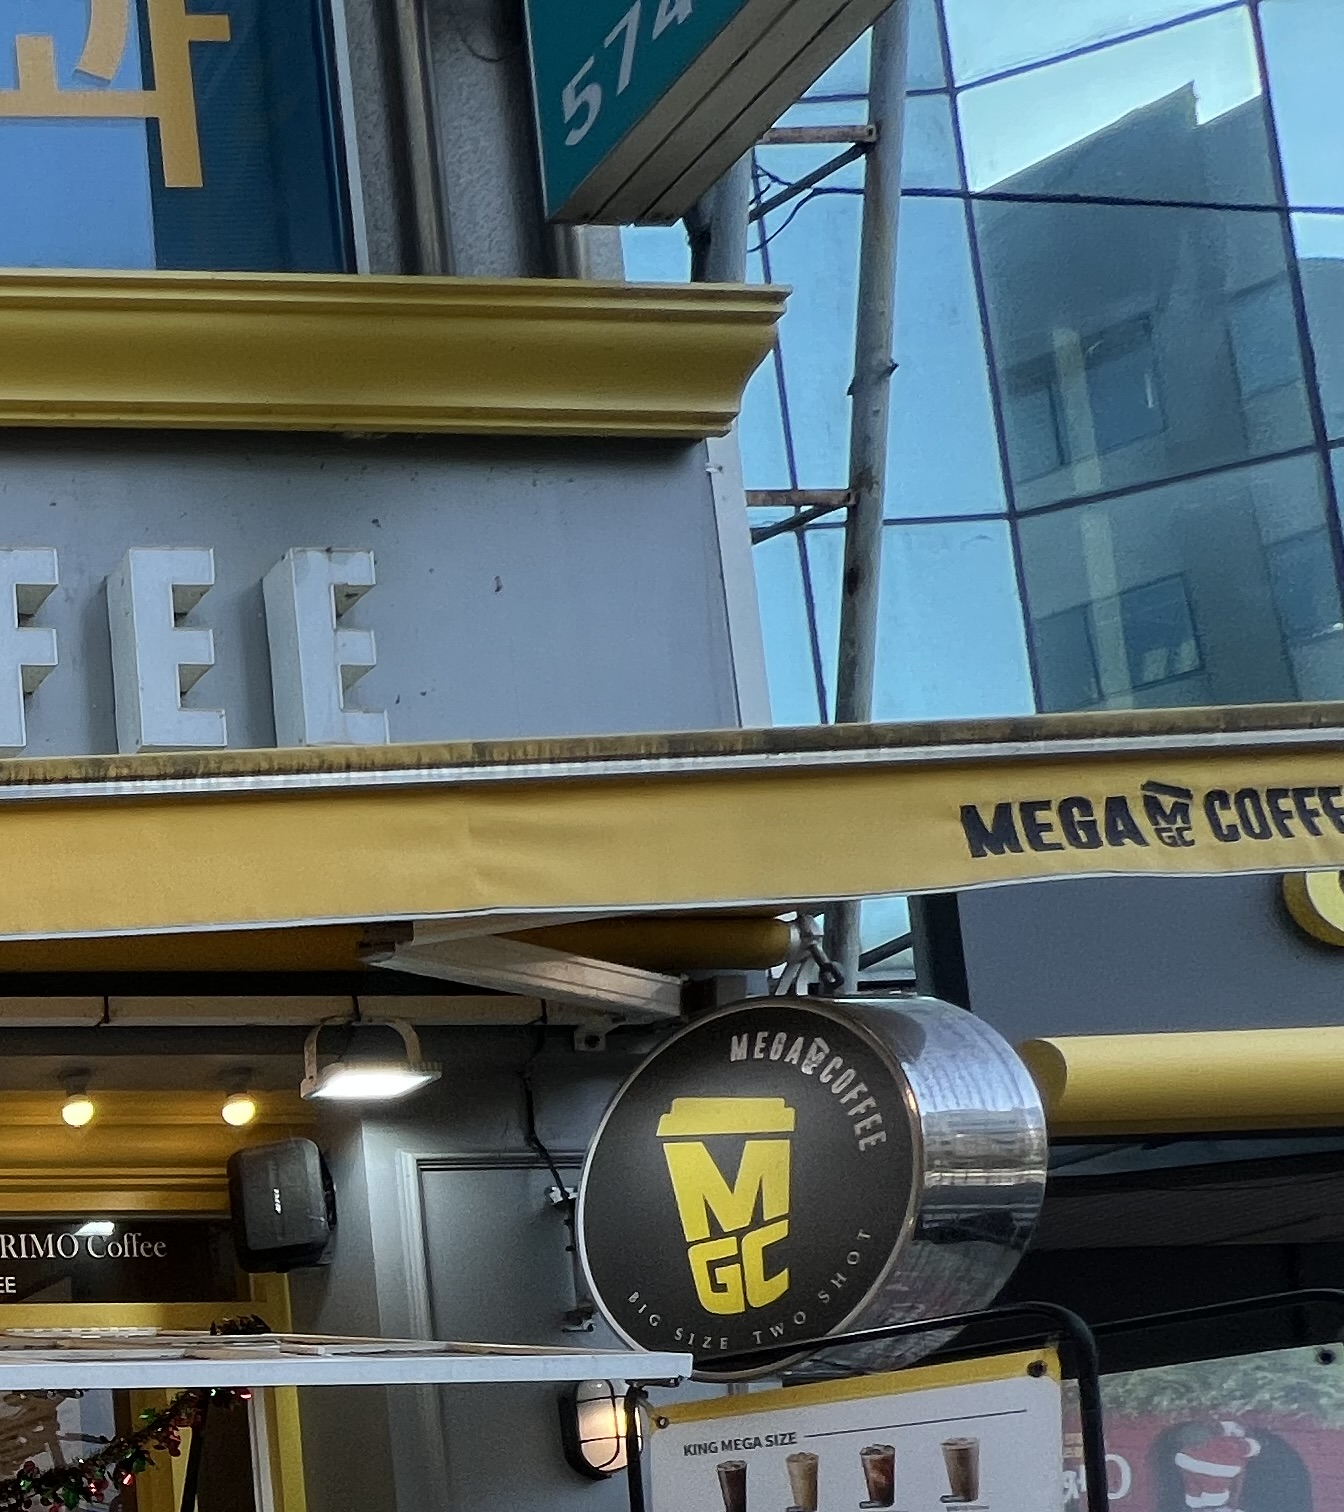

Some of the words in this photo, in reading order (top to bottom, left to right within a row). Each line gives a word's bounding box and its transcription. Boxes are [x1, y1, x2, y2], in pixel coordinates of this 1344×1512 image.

[959, 795, 1150, 859] MEGA
[729, 1031, 802, 1064] MEGA
[818, 1055, 887, 1153] COFFEE
[86, 1232, 168, 1260] Coffee
[662, 1138, 791, 1315] MGC
[625, 1290, 660, 1329] BIG
[673, 1328, 729, 1350] SIZE
[752, 1309, 808, 1346] TWO
[817, 1228, 872, 1304] SHOT
[683, 1440, 718, 1457] KING
[720, 1436, 763, 1453] MEGA
[765, 1431, 798, 1448] SIZE
